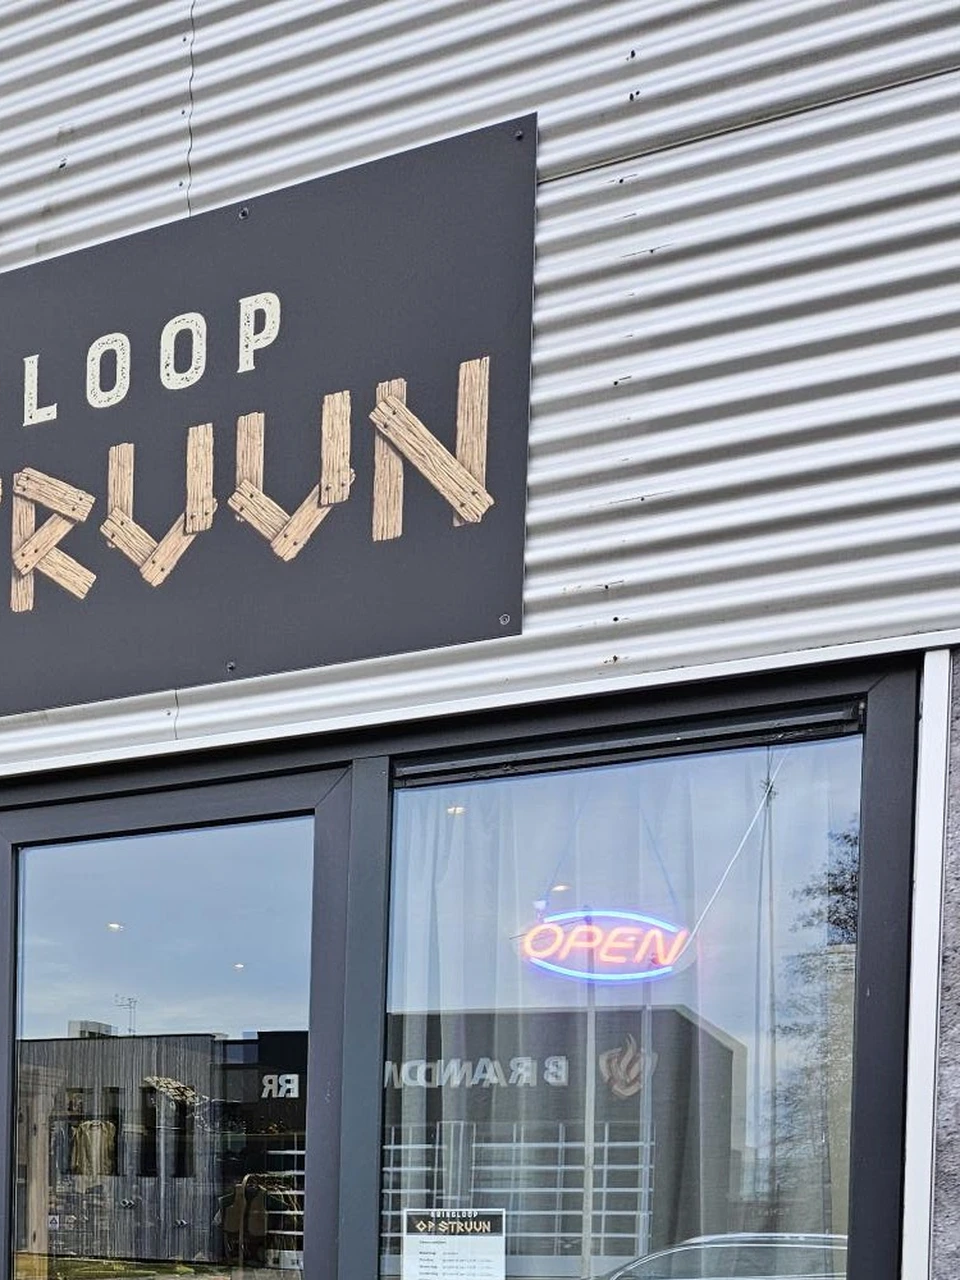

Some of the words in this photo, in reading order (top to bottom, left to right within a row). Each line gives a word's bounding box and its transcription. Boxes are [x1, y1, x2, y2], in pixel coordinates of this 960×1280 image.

[521, 921, 689, 967] OPEN
[415, 1220, 435, 1232] OP
[438, 1220, 492, 1233] STRUUN
